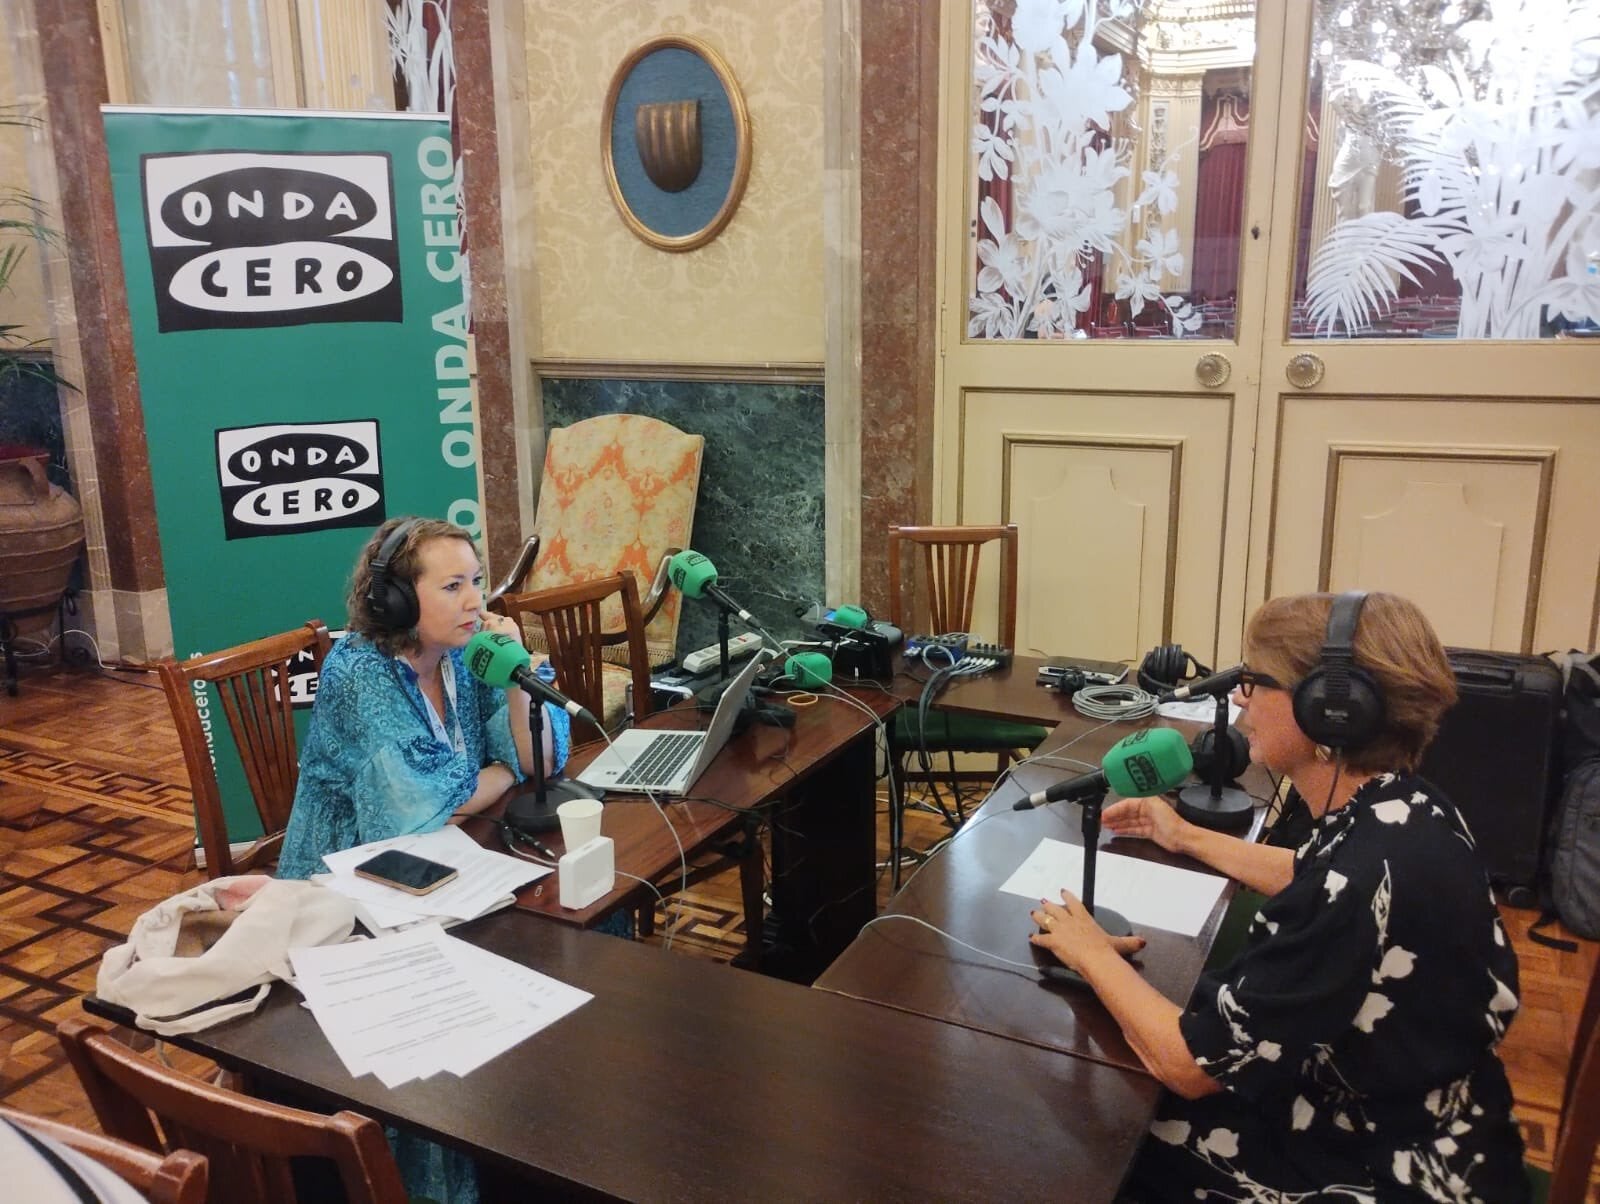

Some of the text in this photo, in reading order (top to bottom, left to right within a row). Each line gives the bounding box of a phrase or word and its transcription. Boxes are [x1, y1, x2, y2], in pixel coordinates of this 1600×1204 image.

[181, 190, 358, 226] ONDA
[417, 136, 462, 283] CERO
[200, 257, 363, 298] CERO
[432, 301, 477, 469] ONDA
[241, 445, 356, 473] ONDA
[253, 487, 360, 517] CERO
